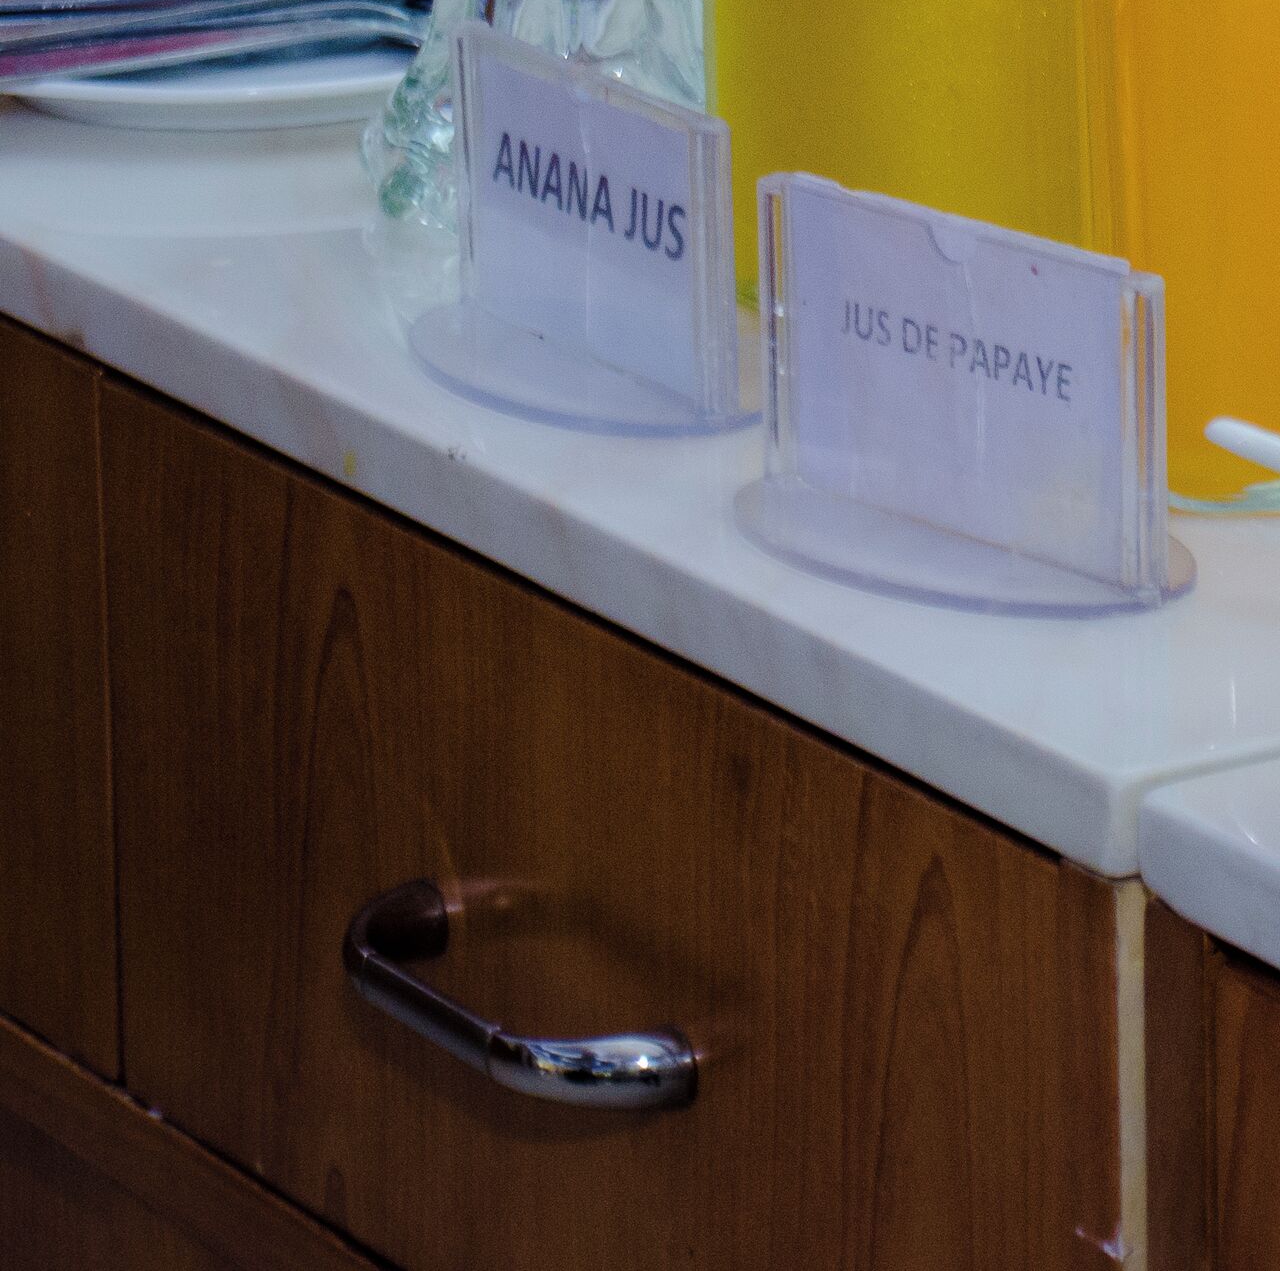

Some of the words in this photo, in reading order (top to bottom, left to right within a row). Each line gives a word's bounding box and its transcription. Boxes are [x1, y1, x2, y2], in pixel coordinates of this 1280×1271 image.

[492, 131, 615, 234] ANANA
[623, 187, 686, 262] JUS
[840, 300, 891, 347] JUS
[901, 316, 939, 361] DE
[949, 332, 1073, 402] PAPAYE
